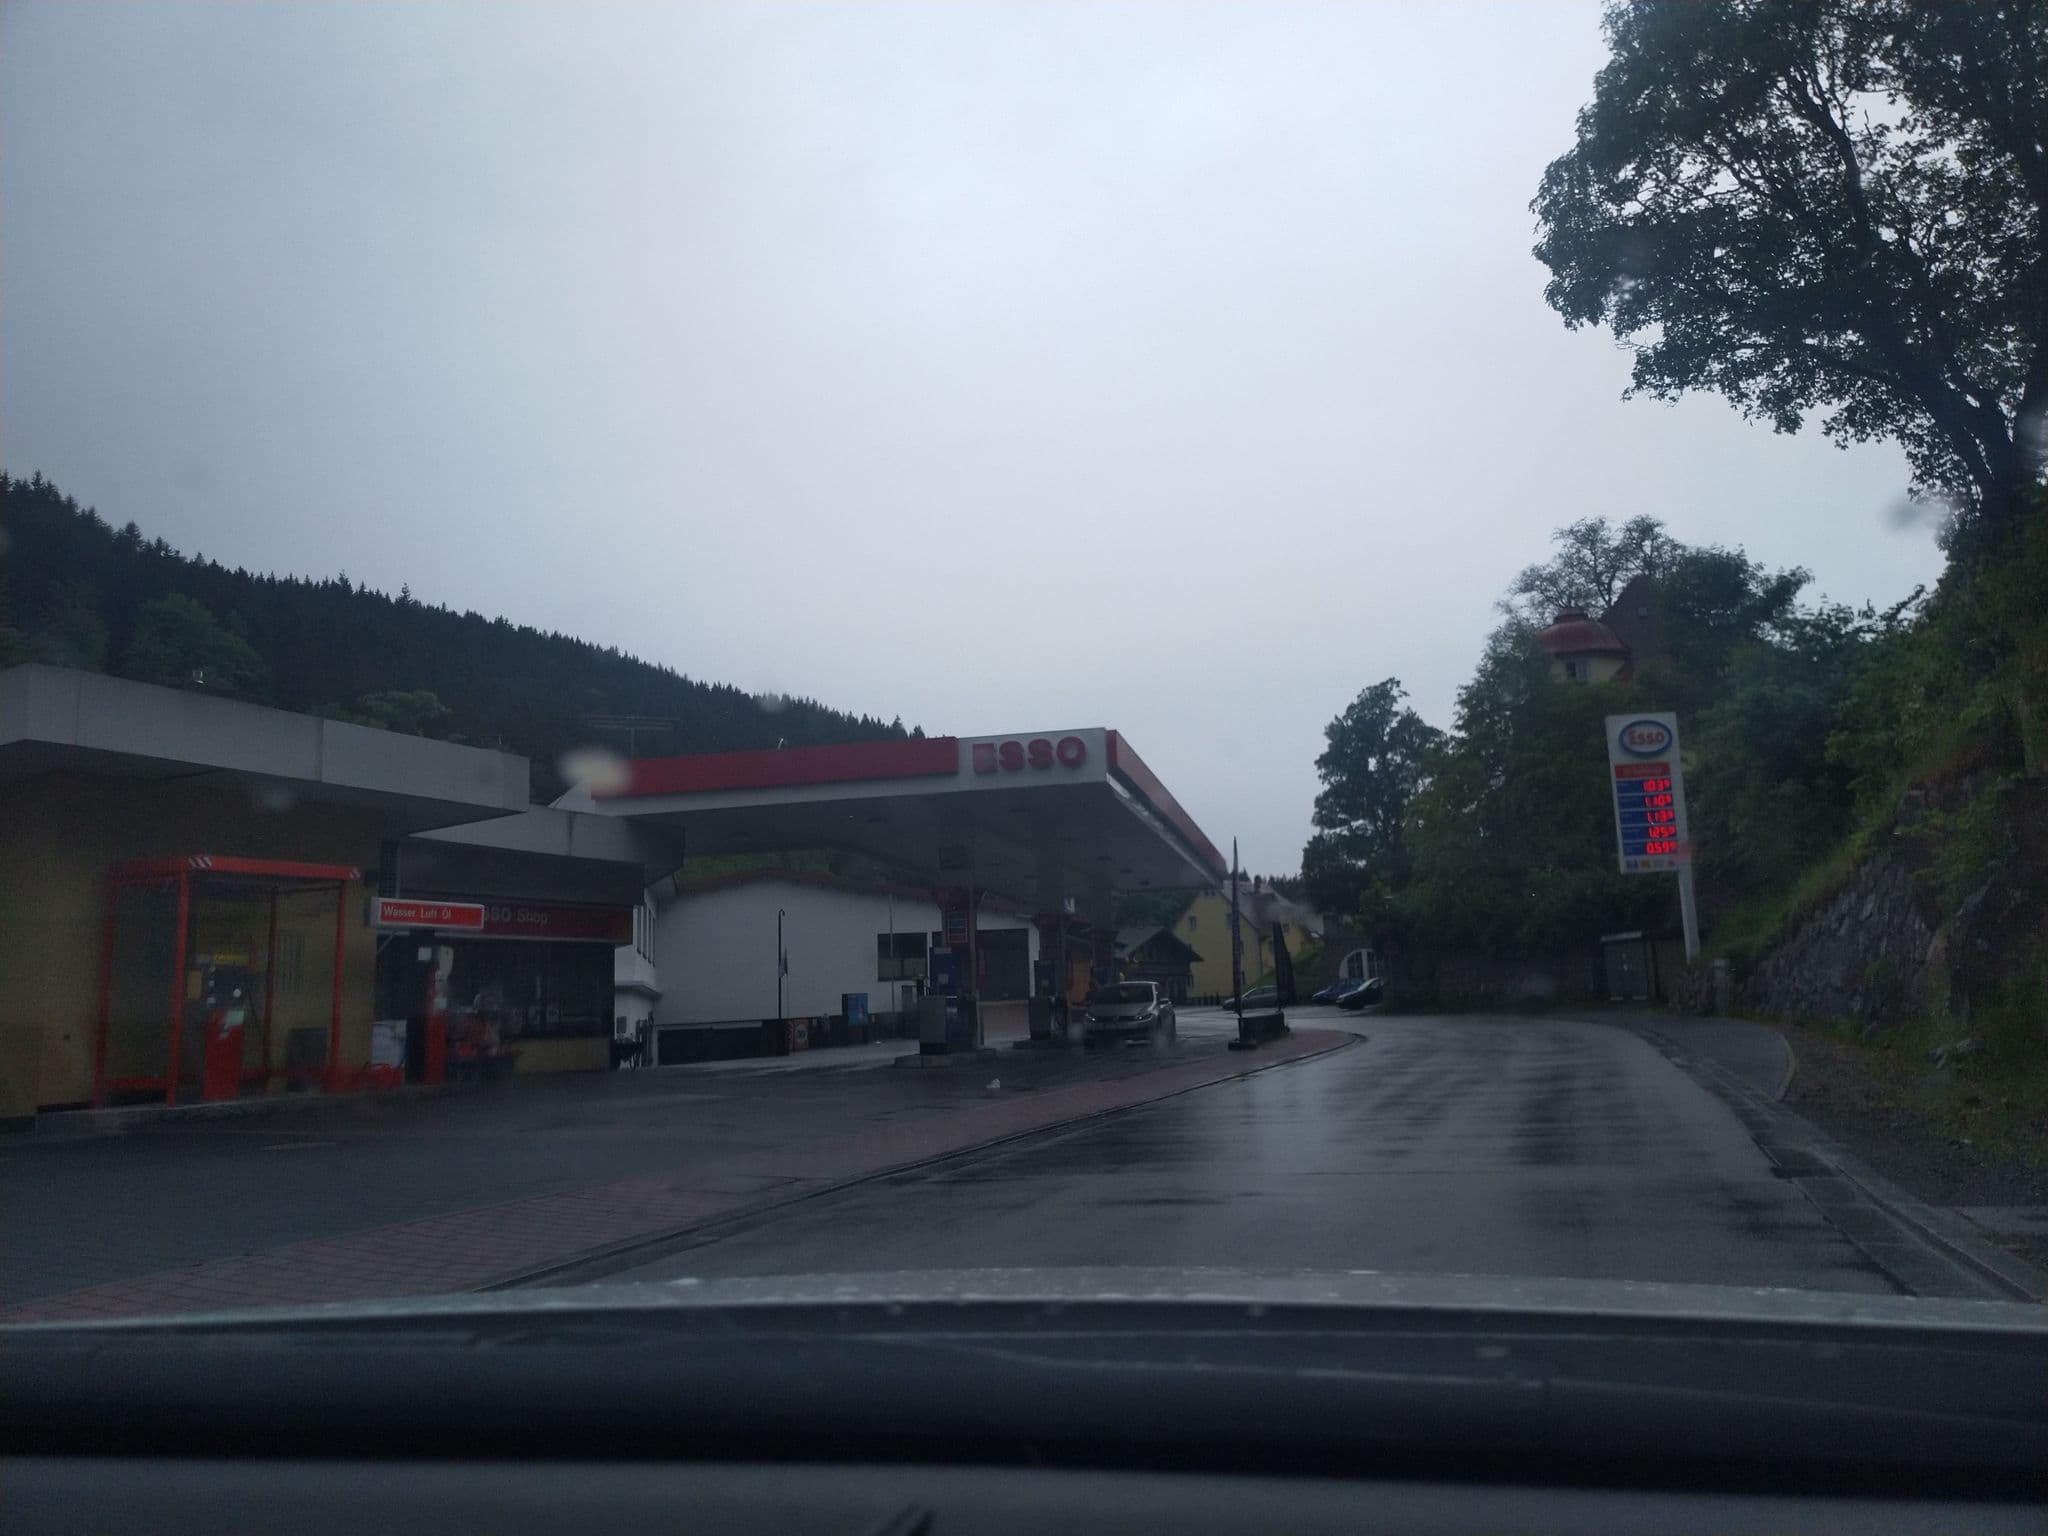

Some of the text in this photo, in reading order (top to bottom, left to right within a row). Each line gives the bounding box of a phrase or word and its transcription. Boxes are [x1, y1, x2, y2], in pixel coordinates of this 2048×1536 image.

[1627, 729, 1665, 745] Esso
[383, 905, 417, 917] Wasser
[420, 909, 438, 919] Luft
[516, 908, 549, 925] Shop
